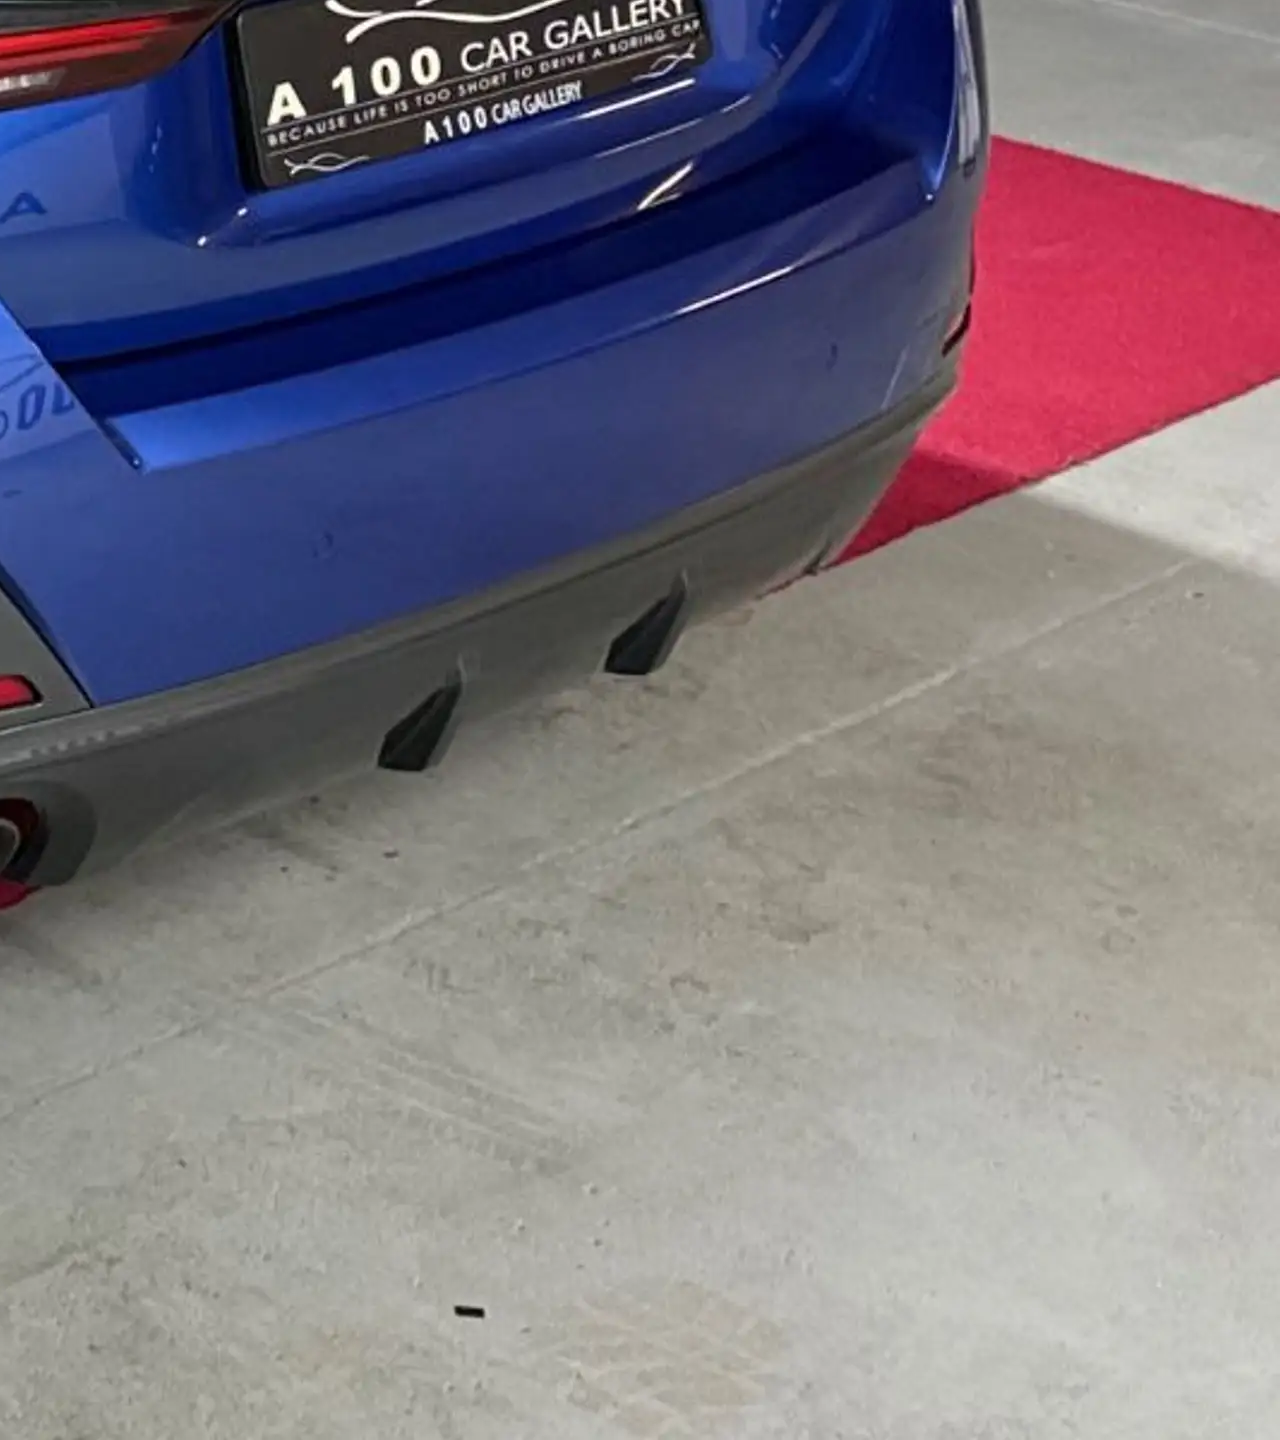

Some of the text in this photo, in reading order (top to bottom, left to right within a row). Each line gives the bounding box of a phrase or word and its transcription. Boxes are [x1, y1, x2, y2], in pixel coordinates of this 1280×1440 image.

[266, 81, 307, 126] A
[331, 46, 441, 109] 100
[460, 30, 533, 72] CAR
[267, 114, 348, 147] BECAUSE
[353, 105, 389, 125] LIFE
[395, 99, 409, 113] IS
[415, 88, 452, 107] TOO
[457, 71, 507, 97] SHORT
[514, 65, 534, 82] TO
[539, 50, 586, 74] DRIVE
[592, 46, 605, 60] A
[608, 27, 666, 55] BORING
